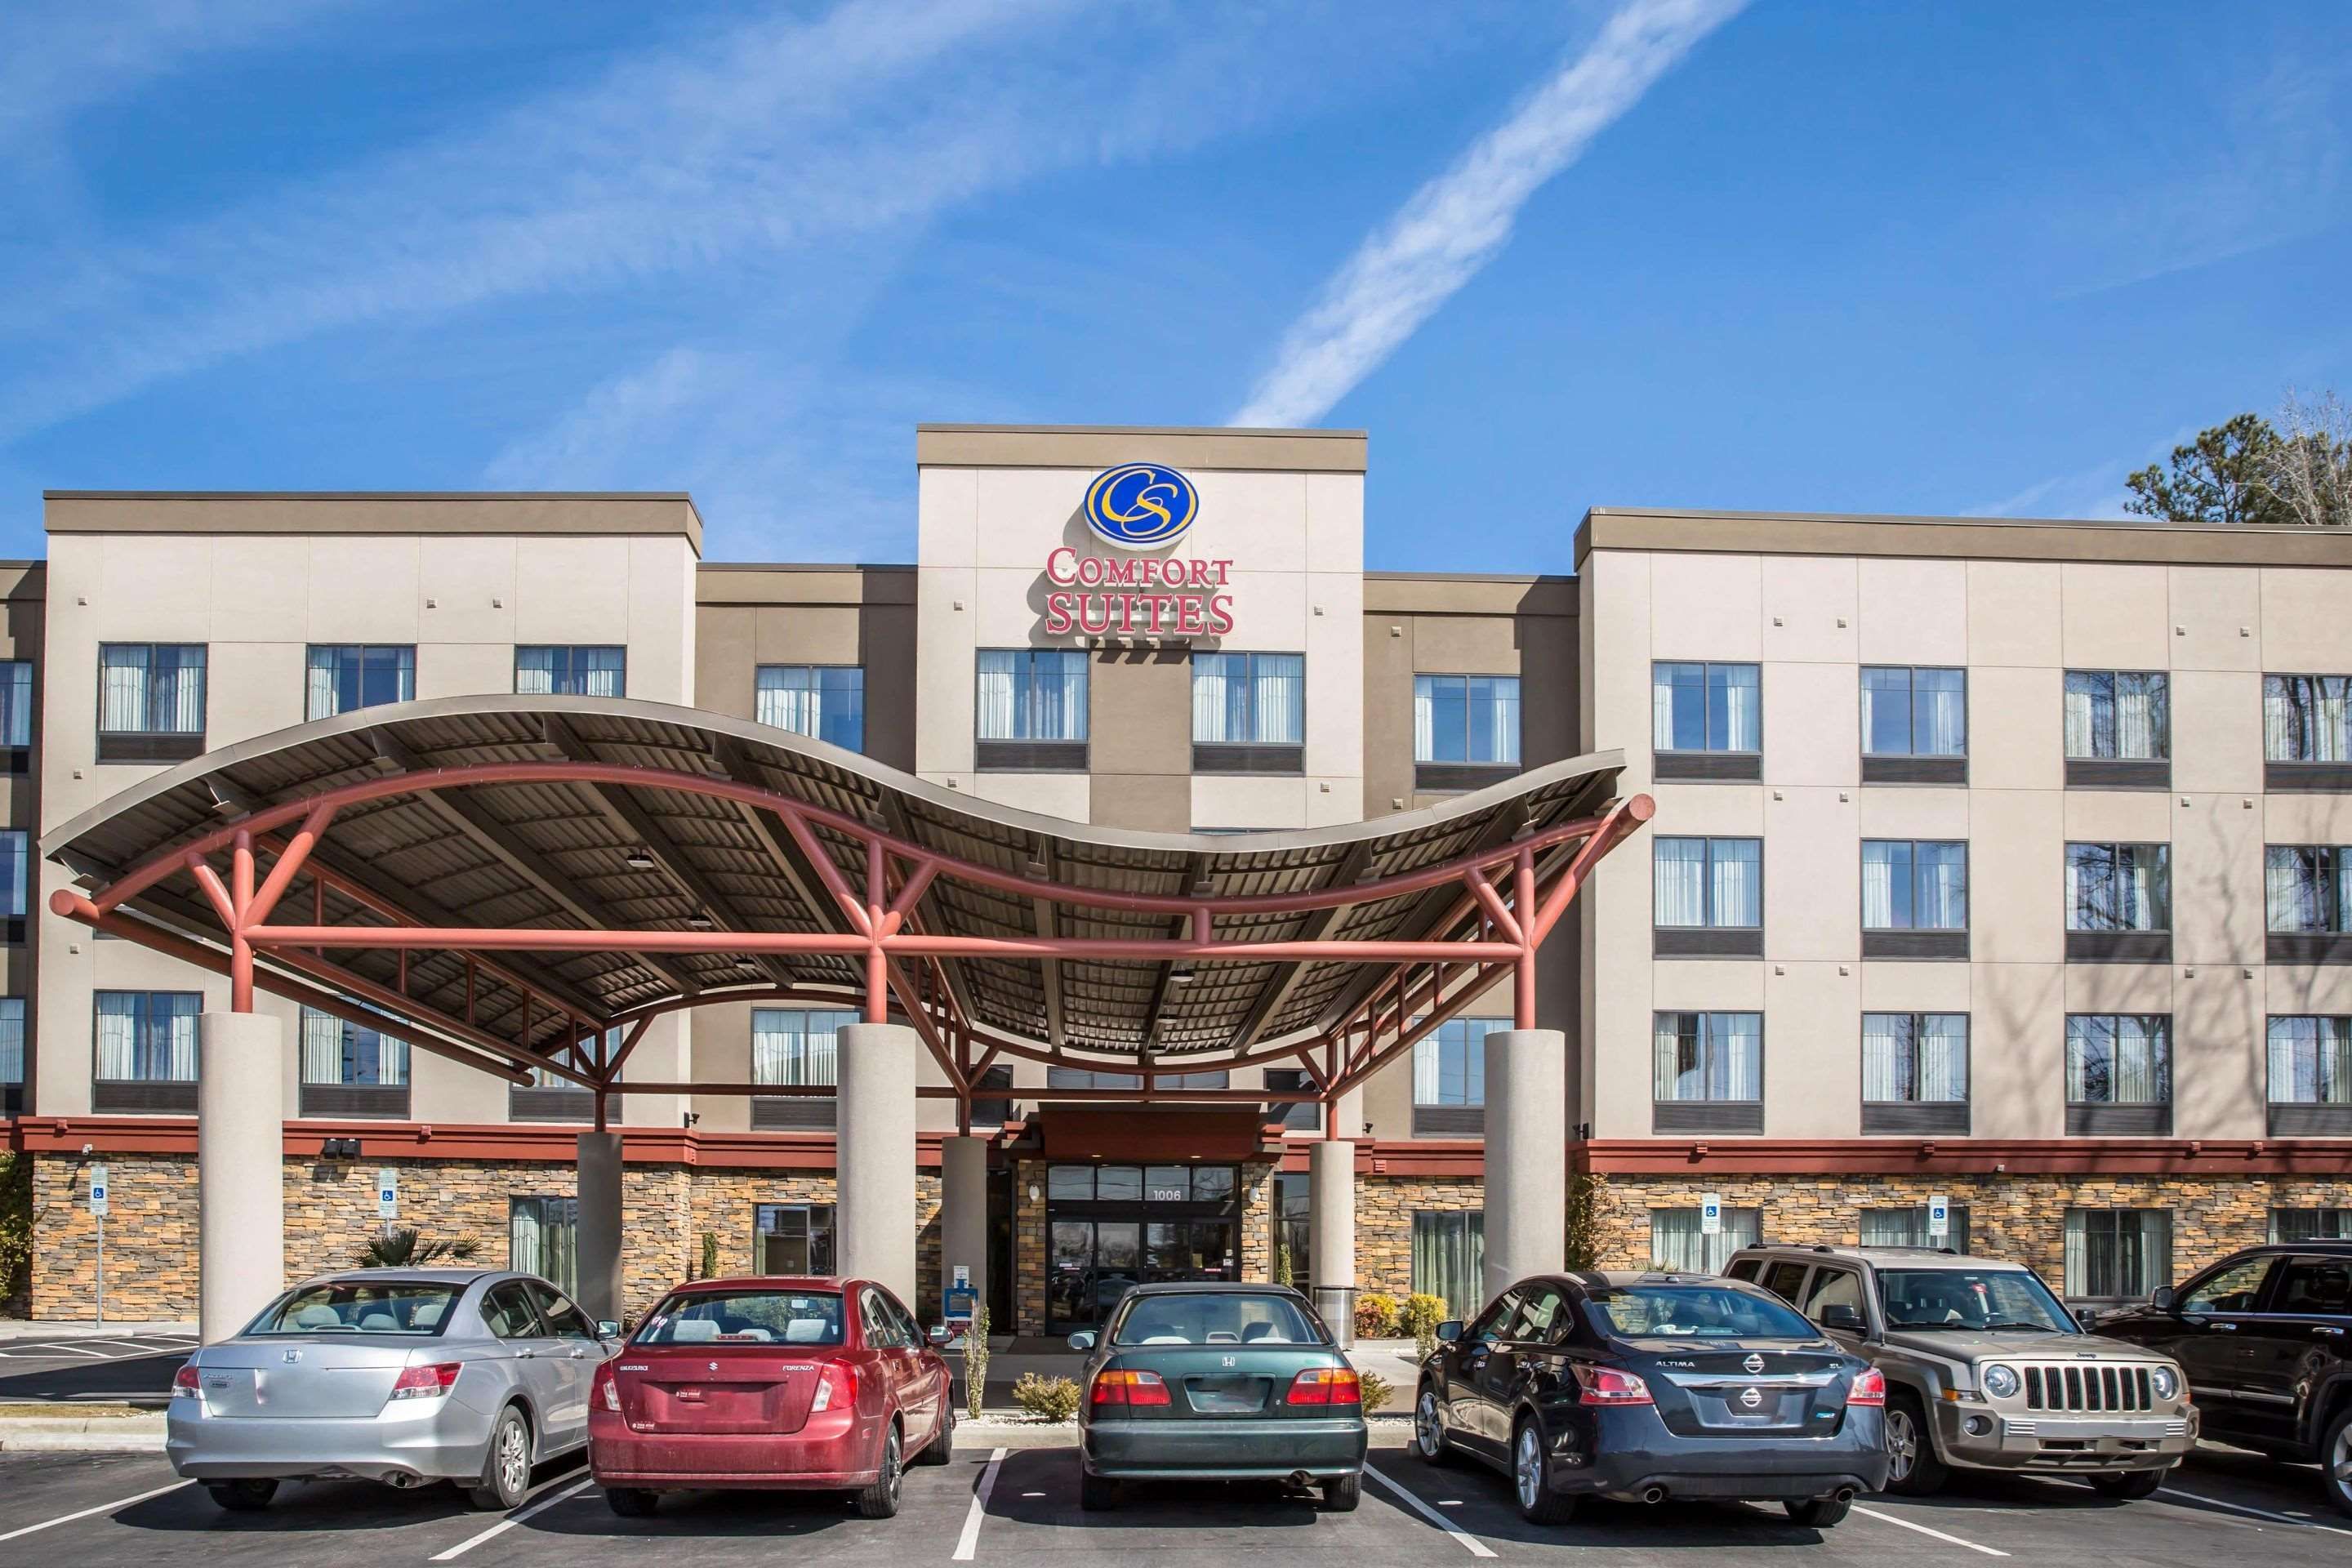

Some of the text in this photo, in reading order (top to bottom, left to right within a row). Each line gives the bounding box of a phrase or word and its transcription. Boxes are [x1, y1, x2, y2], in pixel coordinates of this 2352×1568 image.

[1045, 546, 1234, 588] COMFORT
[1045, 591, 1234, 635] SUITES
[1153, 1190, 1181, 1200] 1006
